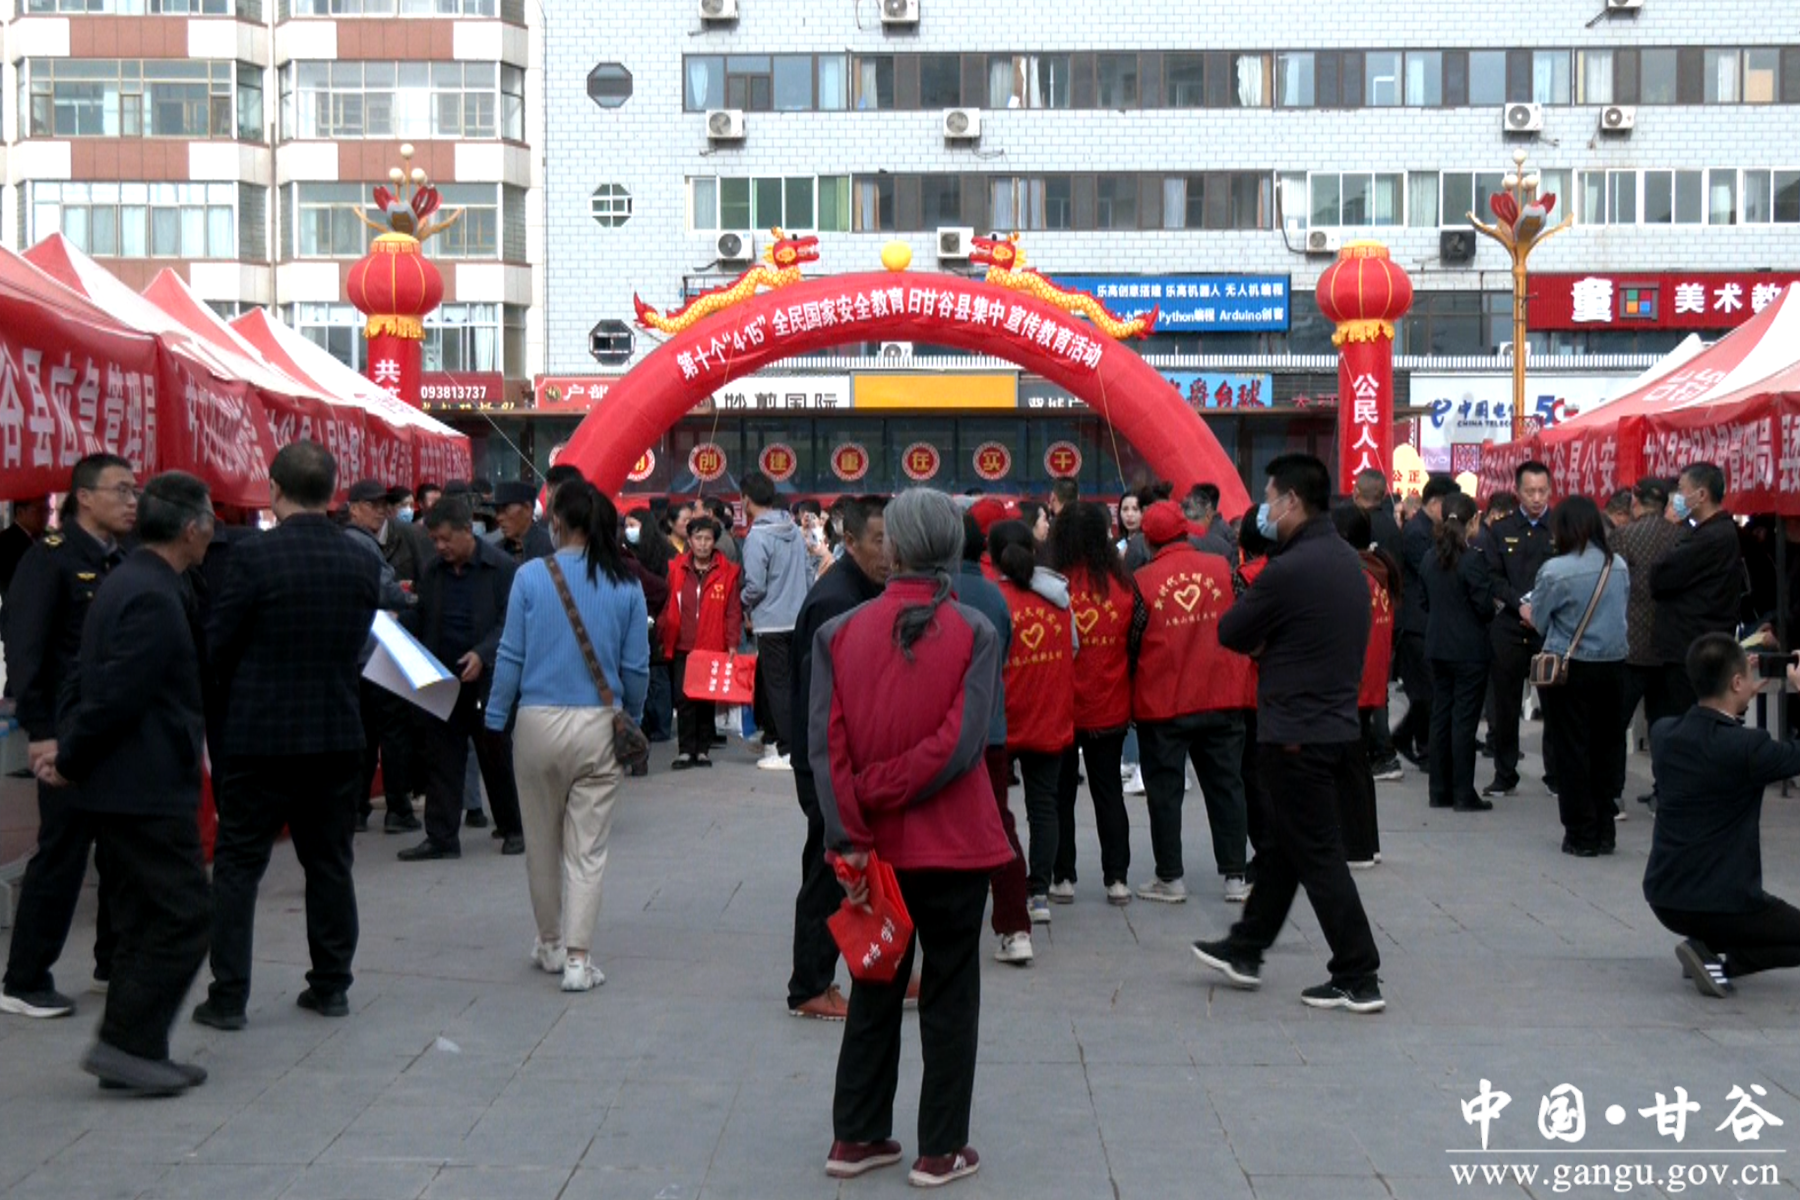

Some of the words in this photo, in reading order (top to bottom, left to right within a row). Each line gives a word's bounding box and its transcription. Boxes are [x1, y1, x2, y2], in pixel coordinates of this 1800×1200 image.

[1352, 372, 1379, 485] 公民人人
[1457, 420, 1483, 428] CHINA
